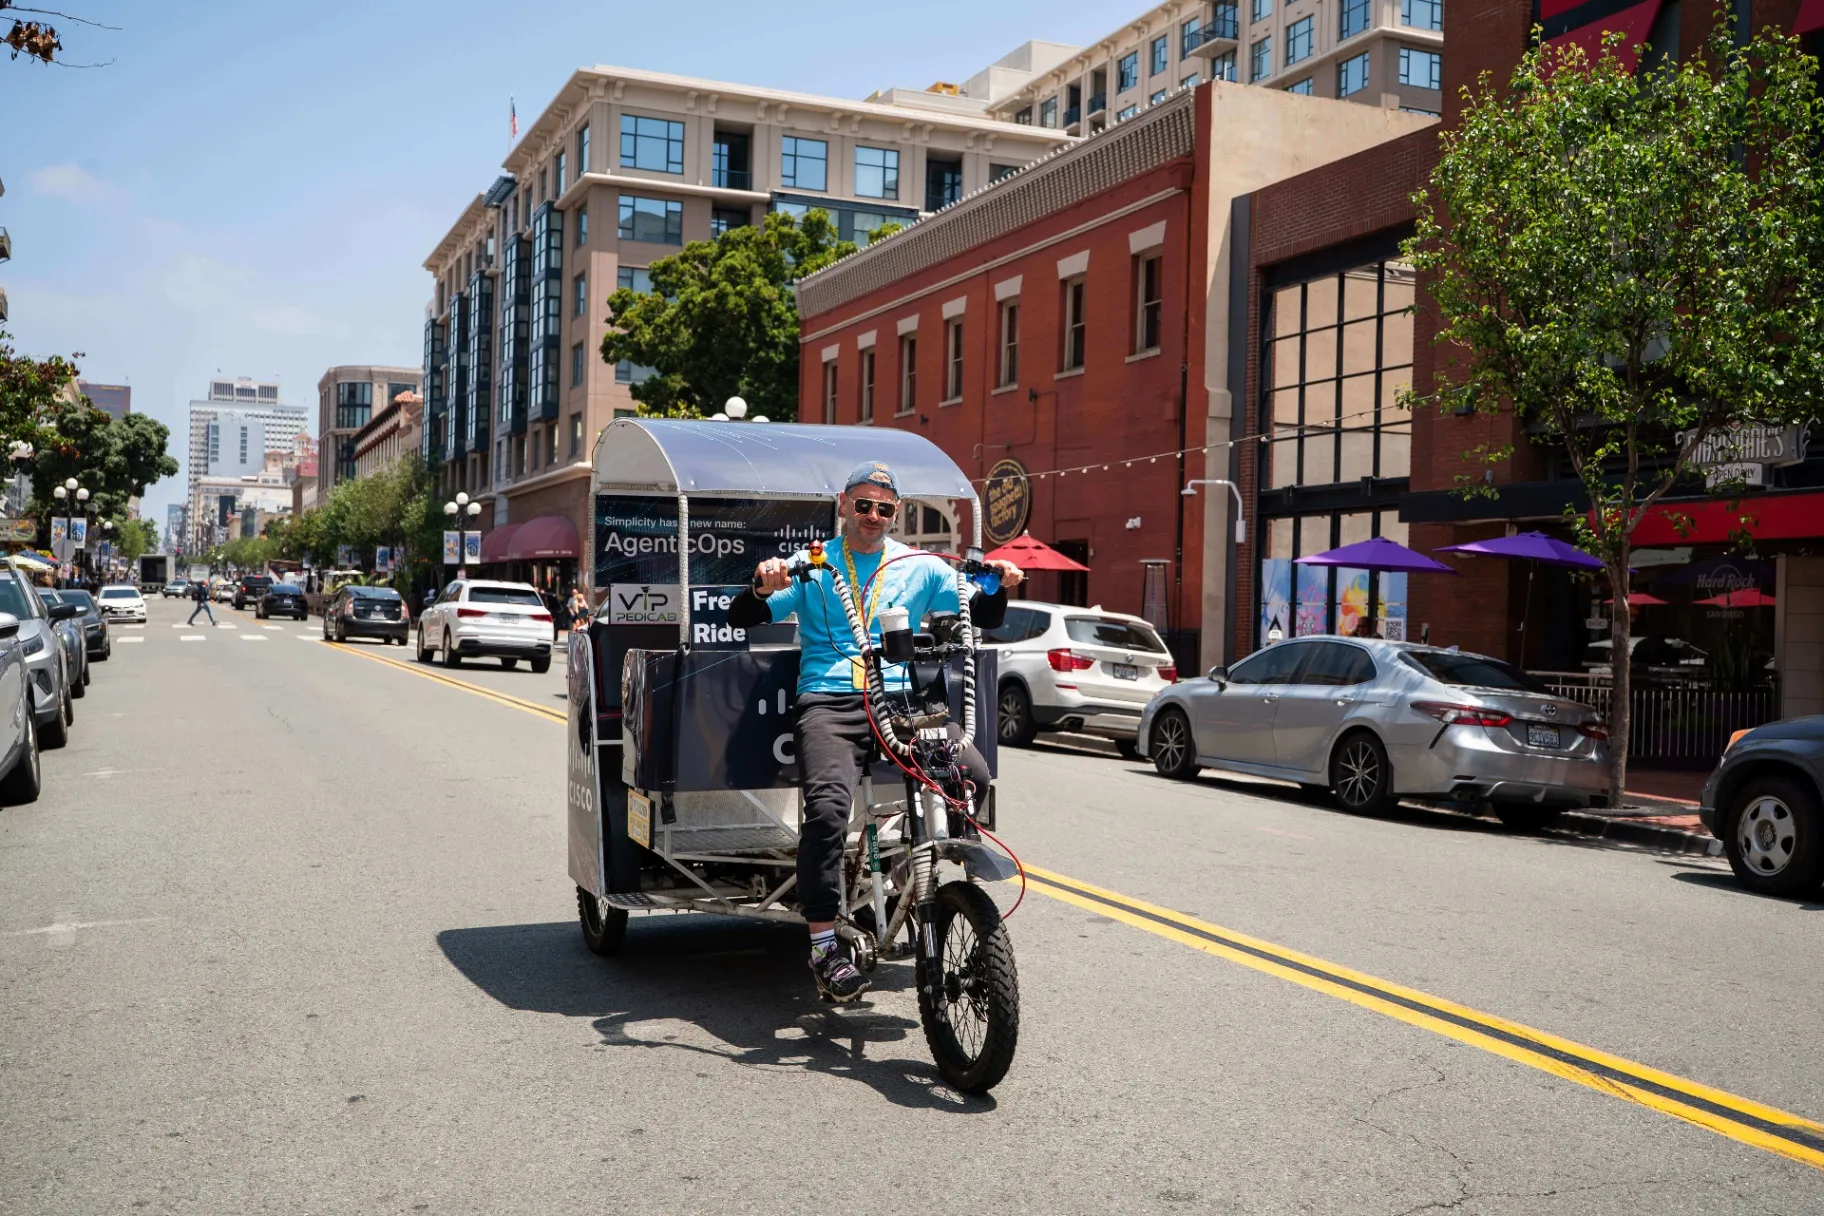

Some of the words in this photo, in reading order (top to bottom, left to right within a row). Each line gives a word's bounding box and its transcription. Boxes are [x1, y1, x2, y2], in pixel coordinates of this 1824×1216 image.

[1713, 468, 1733, 481] OPEN
[604, 516, 656, 529] Simplicity
[659, 518, 678, 527] has
[690, 519, 712, 528] new
[714, 520, 746, 529] name:
[604, 531, 745, 558] AgentcOps
[778, 542, 810, 553] CISC
[1696, 573, 1727, 588] Hard
[1726, 572, 1756, 590] Rock
[618, 587, 668, 611] VIP
[693, 591, 735, 611] Fre
[616, 612, 677, 622] PEDICAB
[1706, 610, 1721, 619] SAN
[1722, 610, 1744, 619] DIEGO
[693, 623, 746, 643] Ride
